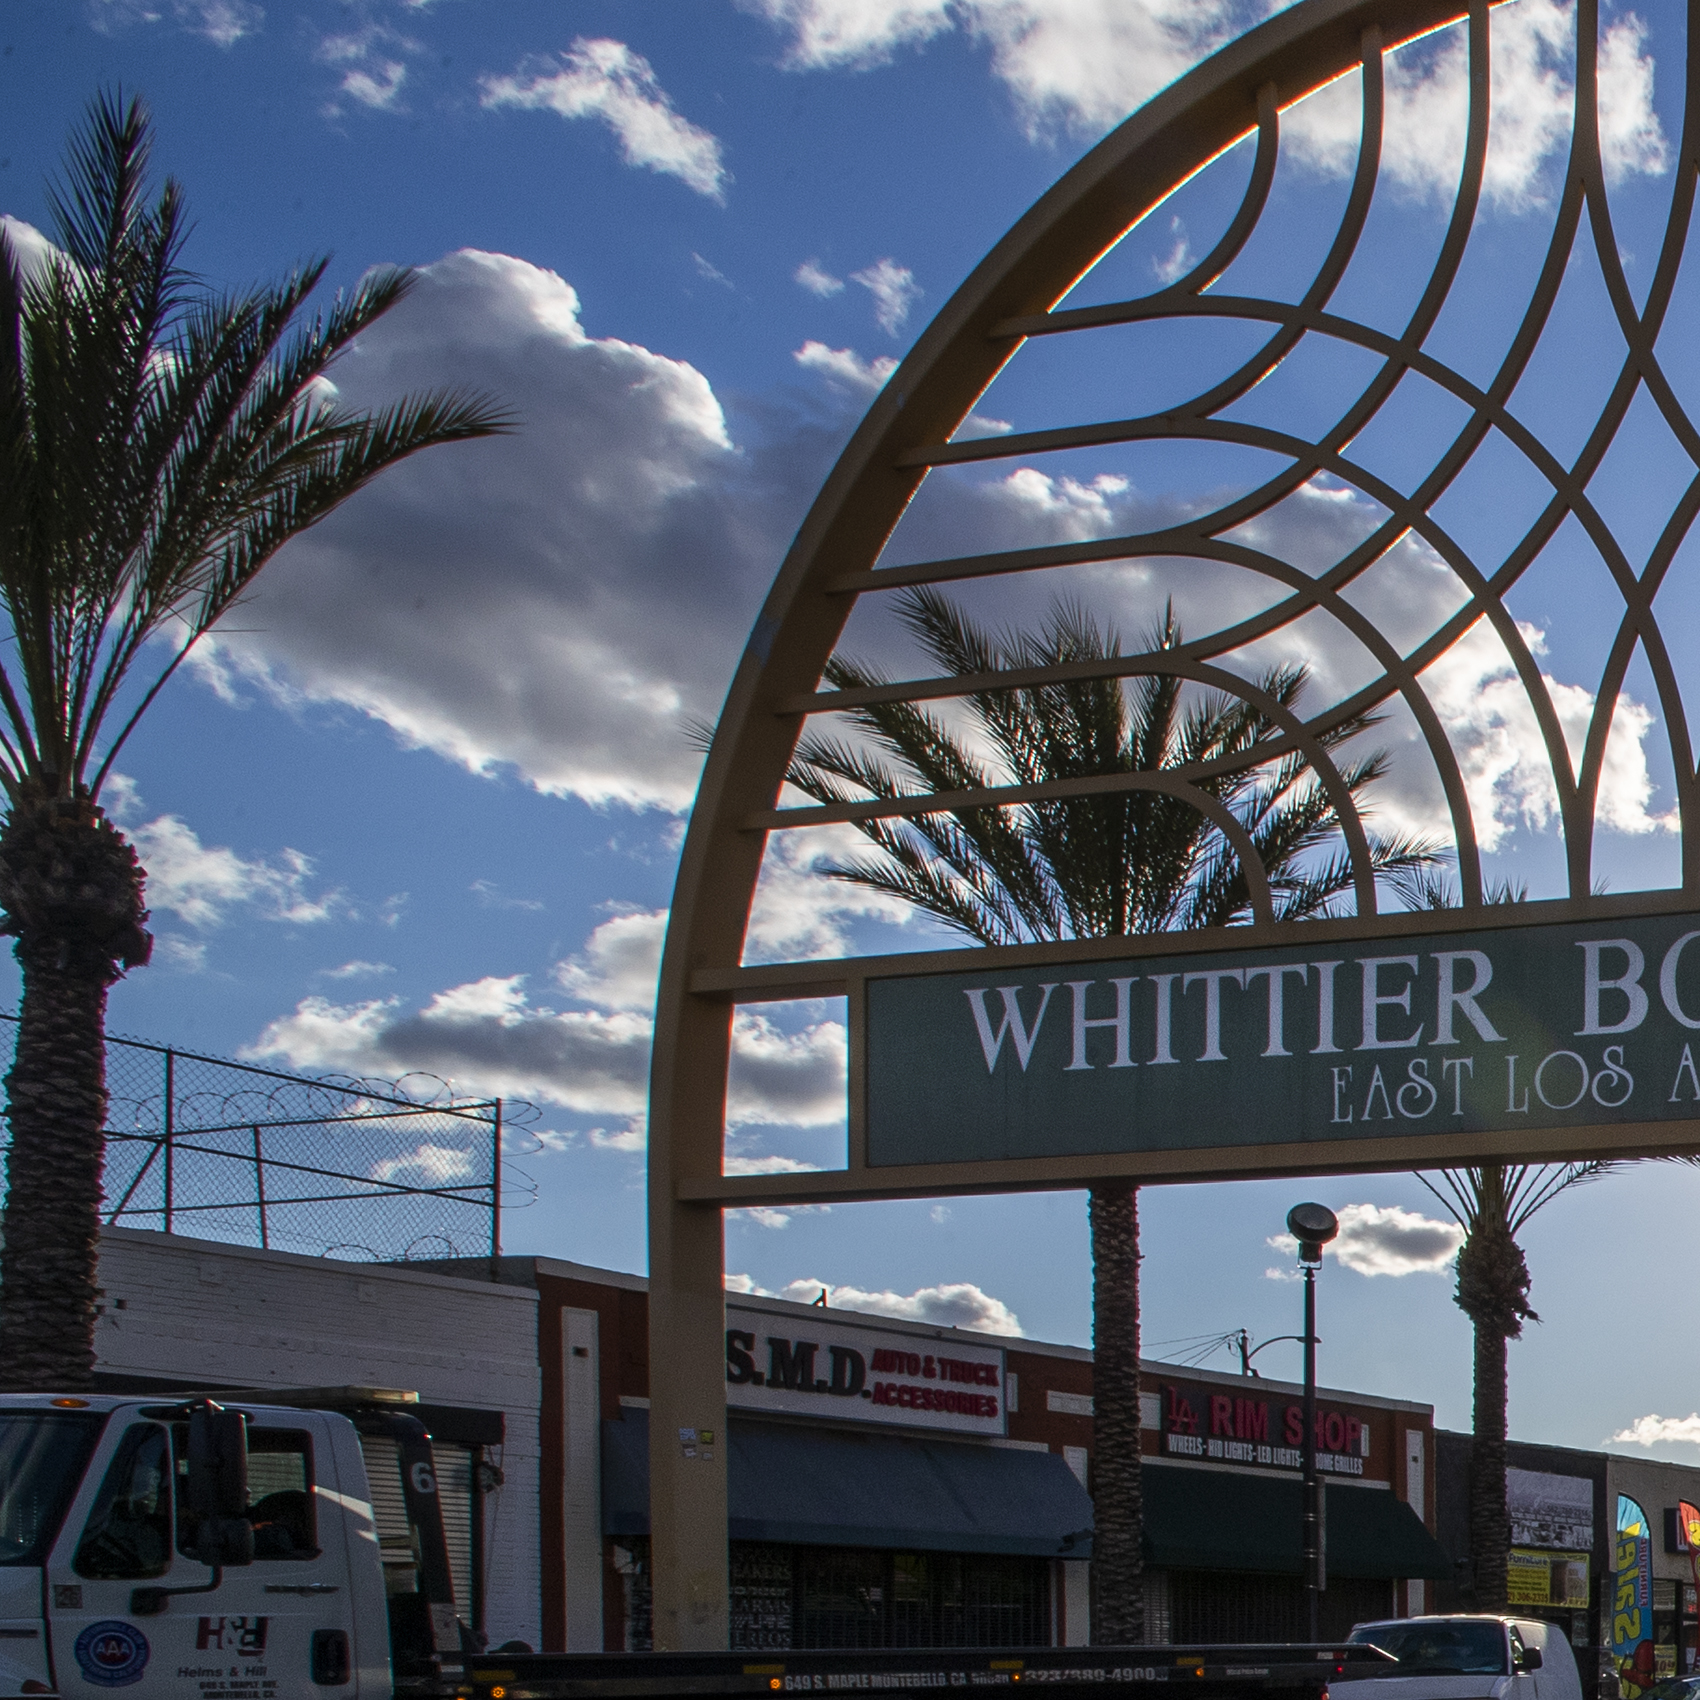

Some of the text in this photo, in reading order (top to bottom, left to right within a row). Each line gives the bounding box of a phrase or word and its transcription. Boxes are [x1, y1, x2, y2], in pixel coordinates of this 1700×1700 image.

[963, 949, 1507, 1074] WHITTIER
[1330, 1056, 1474, 1124] EAST
[1505, 1045, 1633, 1114] LOS
[726, 1329, 872, 1398] S.M.D.
[872, 1348, 999, 1387] AUTO & TRUCK
[872, 1382, 998, 1417] ACCESSORIES
[1167, 1386, 1199, 1434] LA
[1210, 1395, 1269, 1442] RIM
[411, 1461, 437, 1494] 6
[96, 1640, 131, 1656] AAA
[177, 1665, 267, 1678] Helms & Hill
[785, 1675, 811, 1691] 649
[828, 1673, 869, 1688] MAPLE
